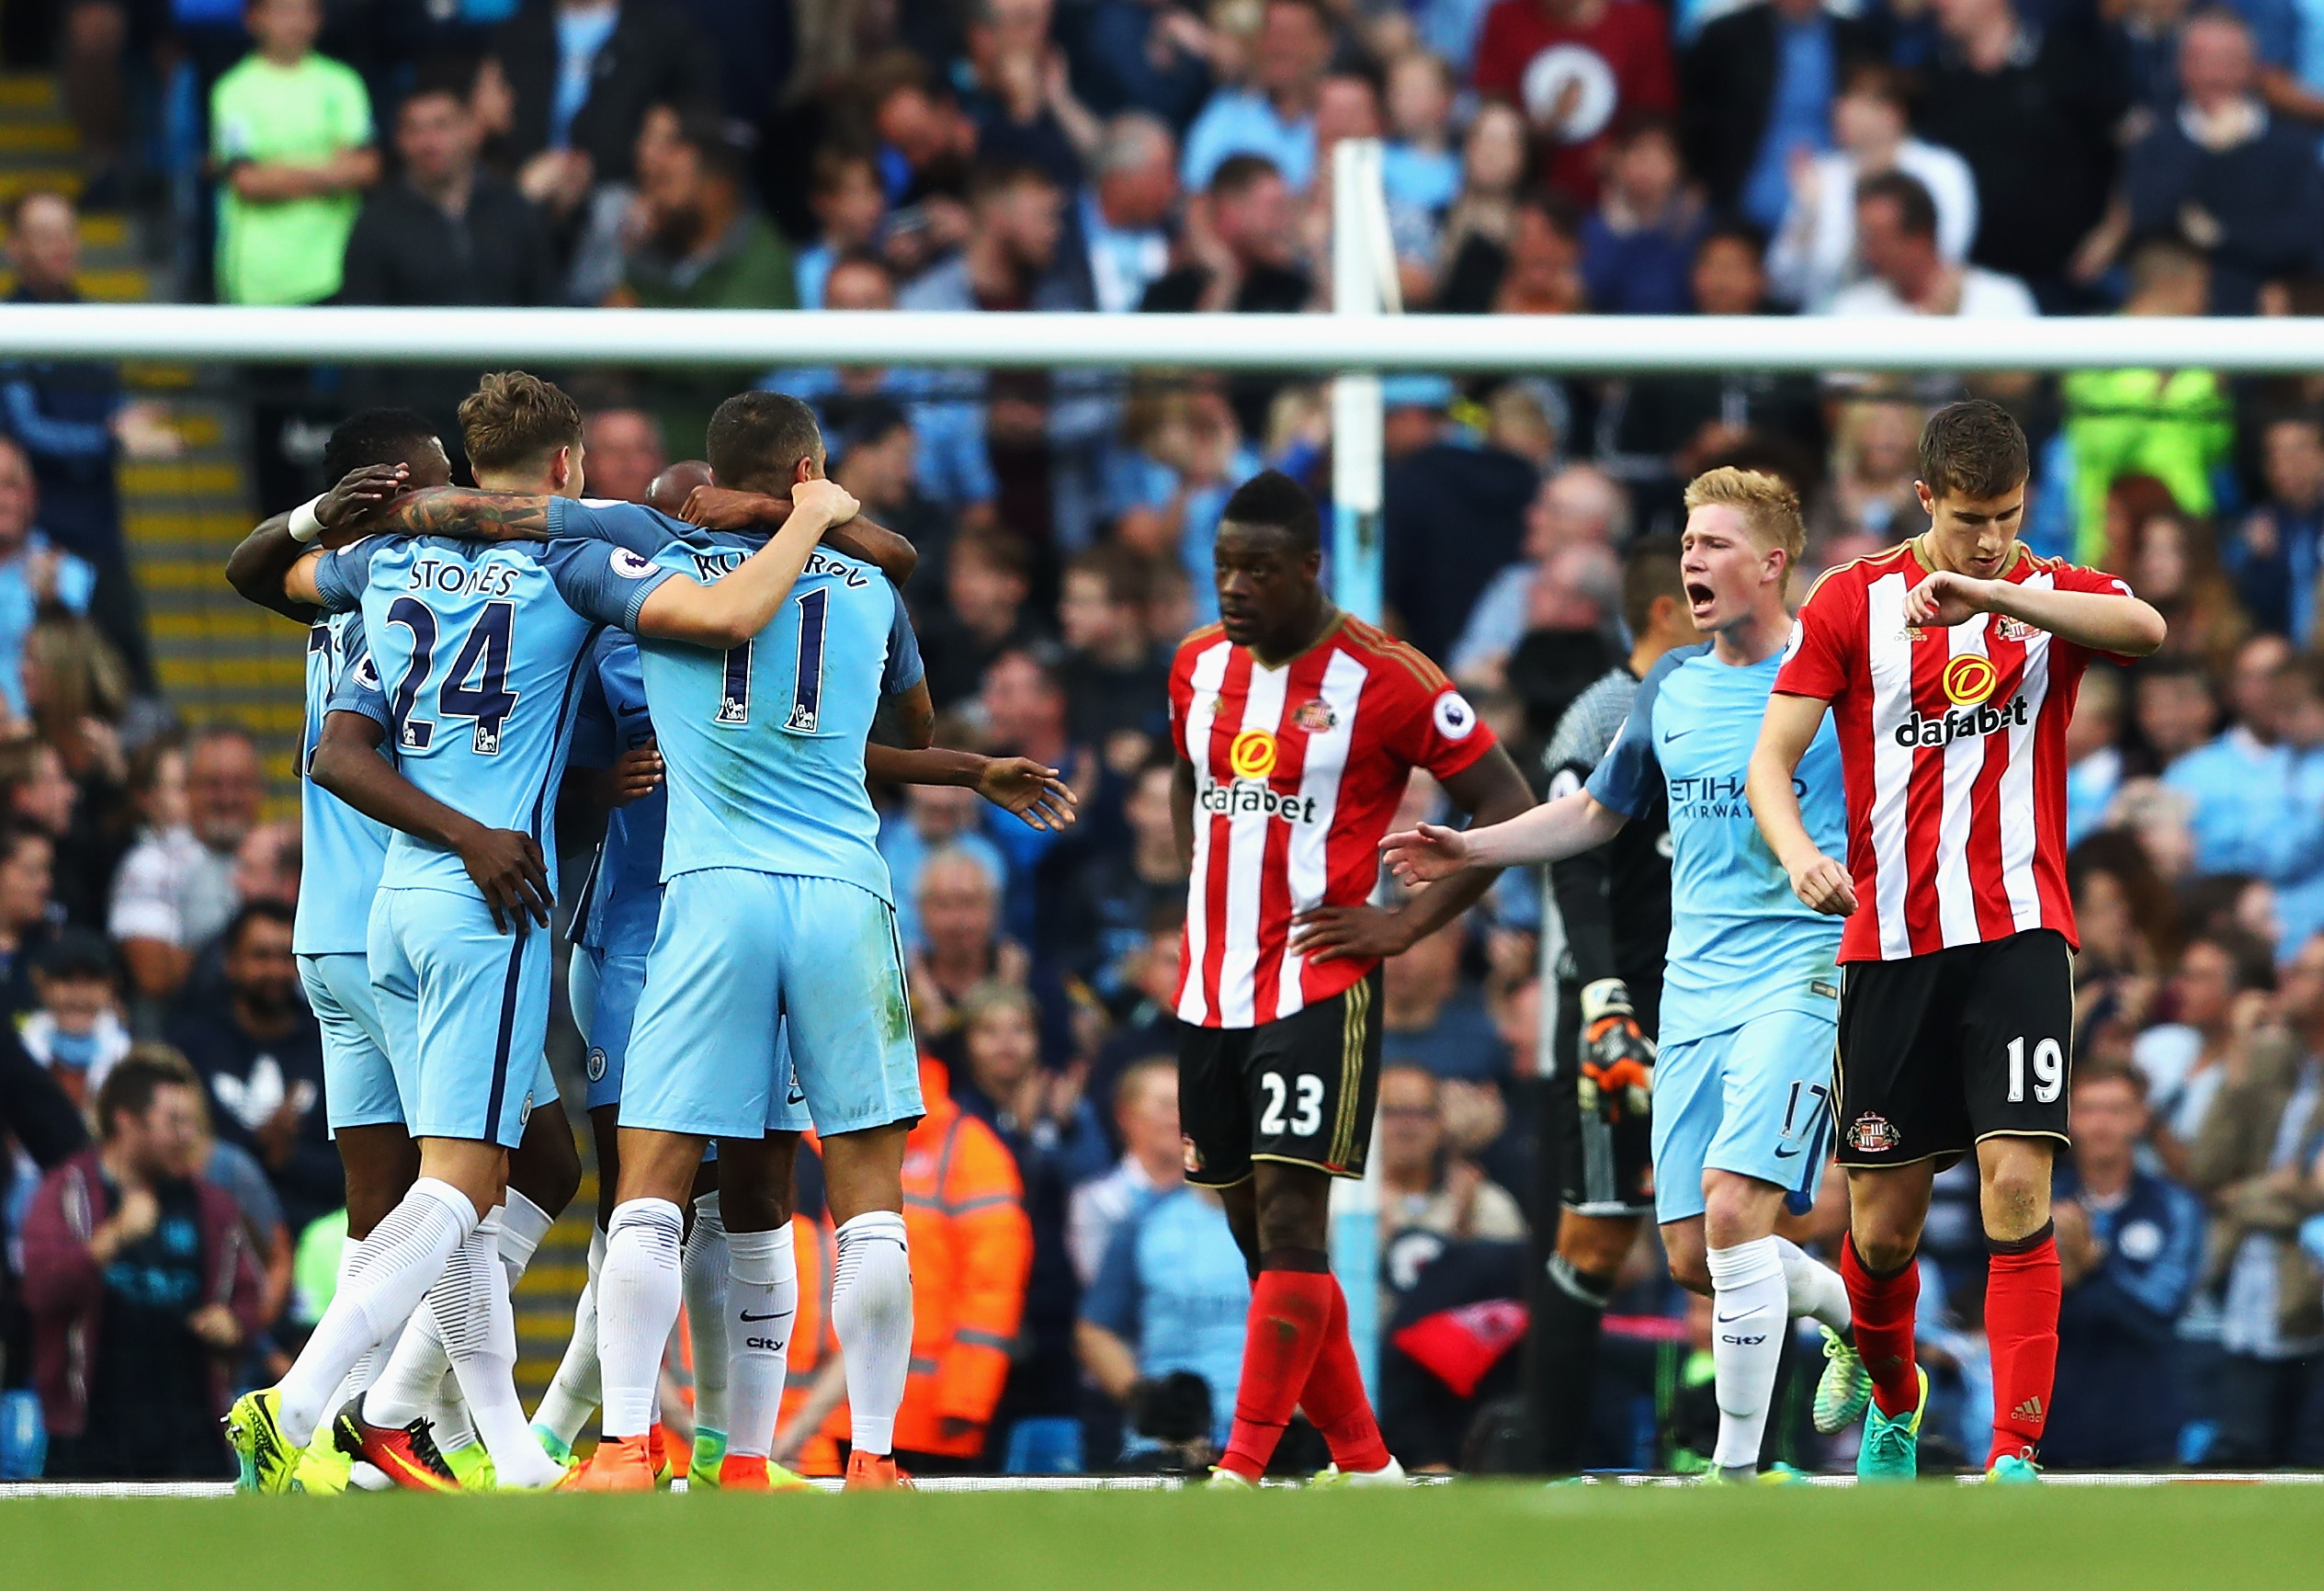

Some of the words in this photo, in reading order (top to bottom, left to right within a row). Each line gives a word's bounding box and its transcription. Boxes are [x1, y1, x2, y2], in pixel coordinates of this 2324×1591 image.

[408, 559, 519, 597] STONES
[694, 552, 868, 589] KOROV
[384, 595, 521, 755] 24
[715, 586, 829, 733] 11
[1895, 695, 2028, 747] dafabet
[1200, 778, 1317, 824] dafabet
[1683, 805, 1755, 819] AIRWAY
[2007, 1036, 2063, 1103] 19
[1260, 1071, 1325, 1136] 23
[1779, 1080, 1830, 1144] 17
[746, 1335, 784, 1351] City
